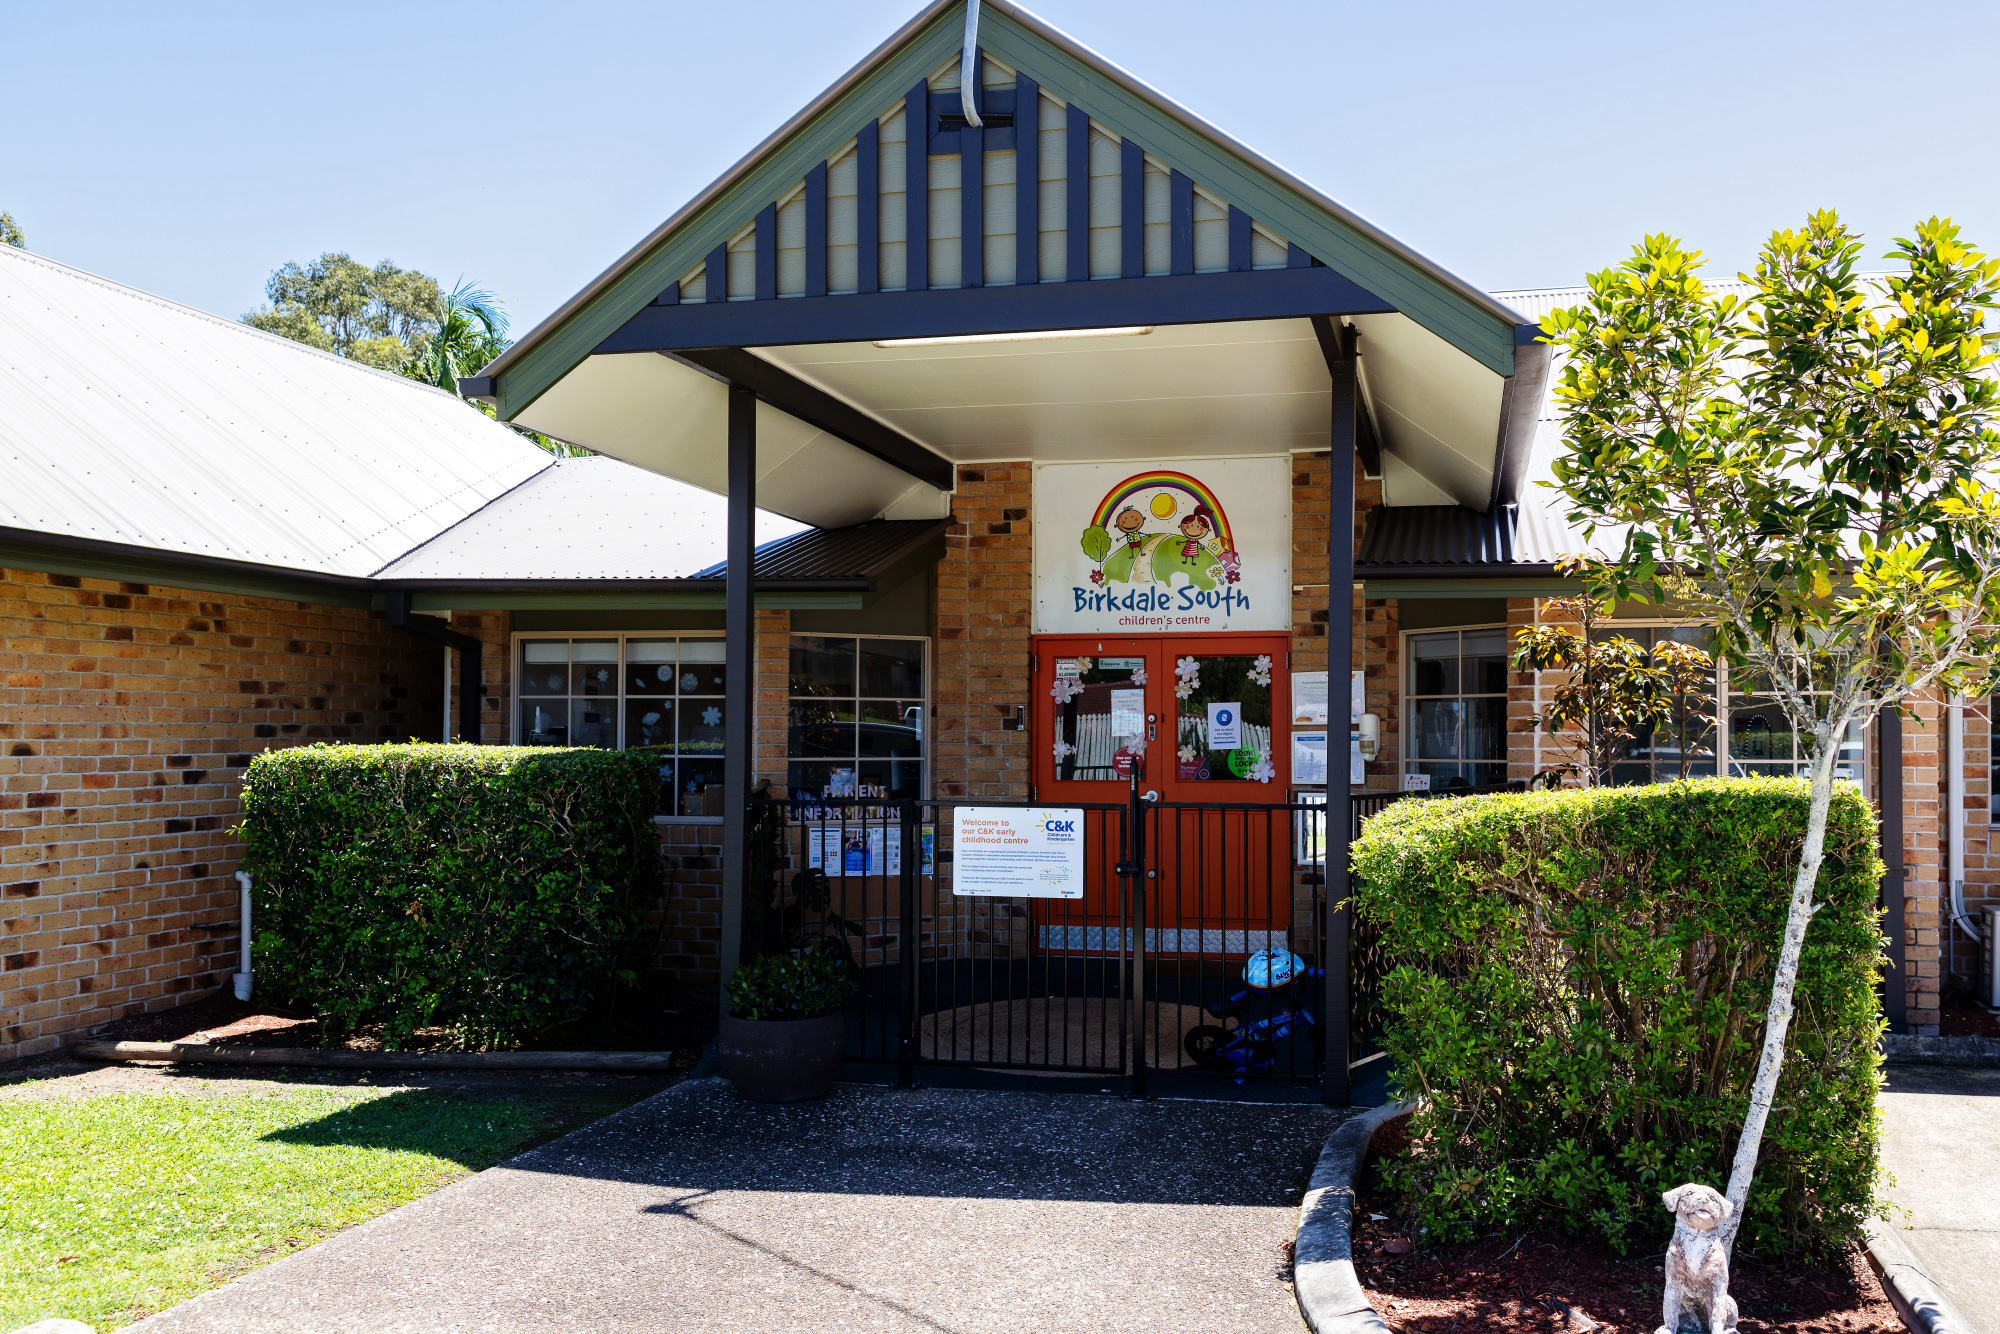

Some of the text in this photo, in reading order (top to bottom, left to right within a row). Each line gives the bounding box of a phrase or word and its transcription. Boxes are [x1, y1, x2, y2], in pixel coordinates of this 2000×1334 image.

[1073, 585, 1250, 617] Birkdale South
[1118, 615, 1210, 626] children's centre
[823, 784, 887, 798] PARENT
[961, 818, 1010, 827] Welcome to
[1045, 820, 1075, 832] C&K
[977, 827, 995, 835] C&K
[996, 828, 1016, 837] early
[961, 836, 1029, 845] childhood centre
